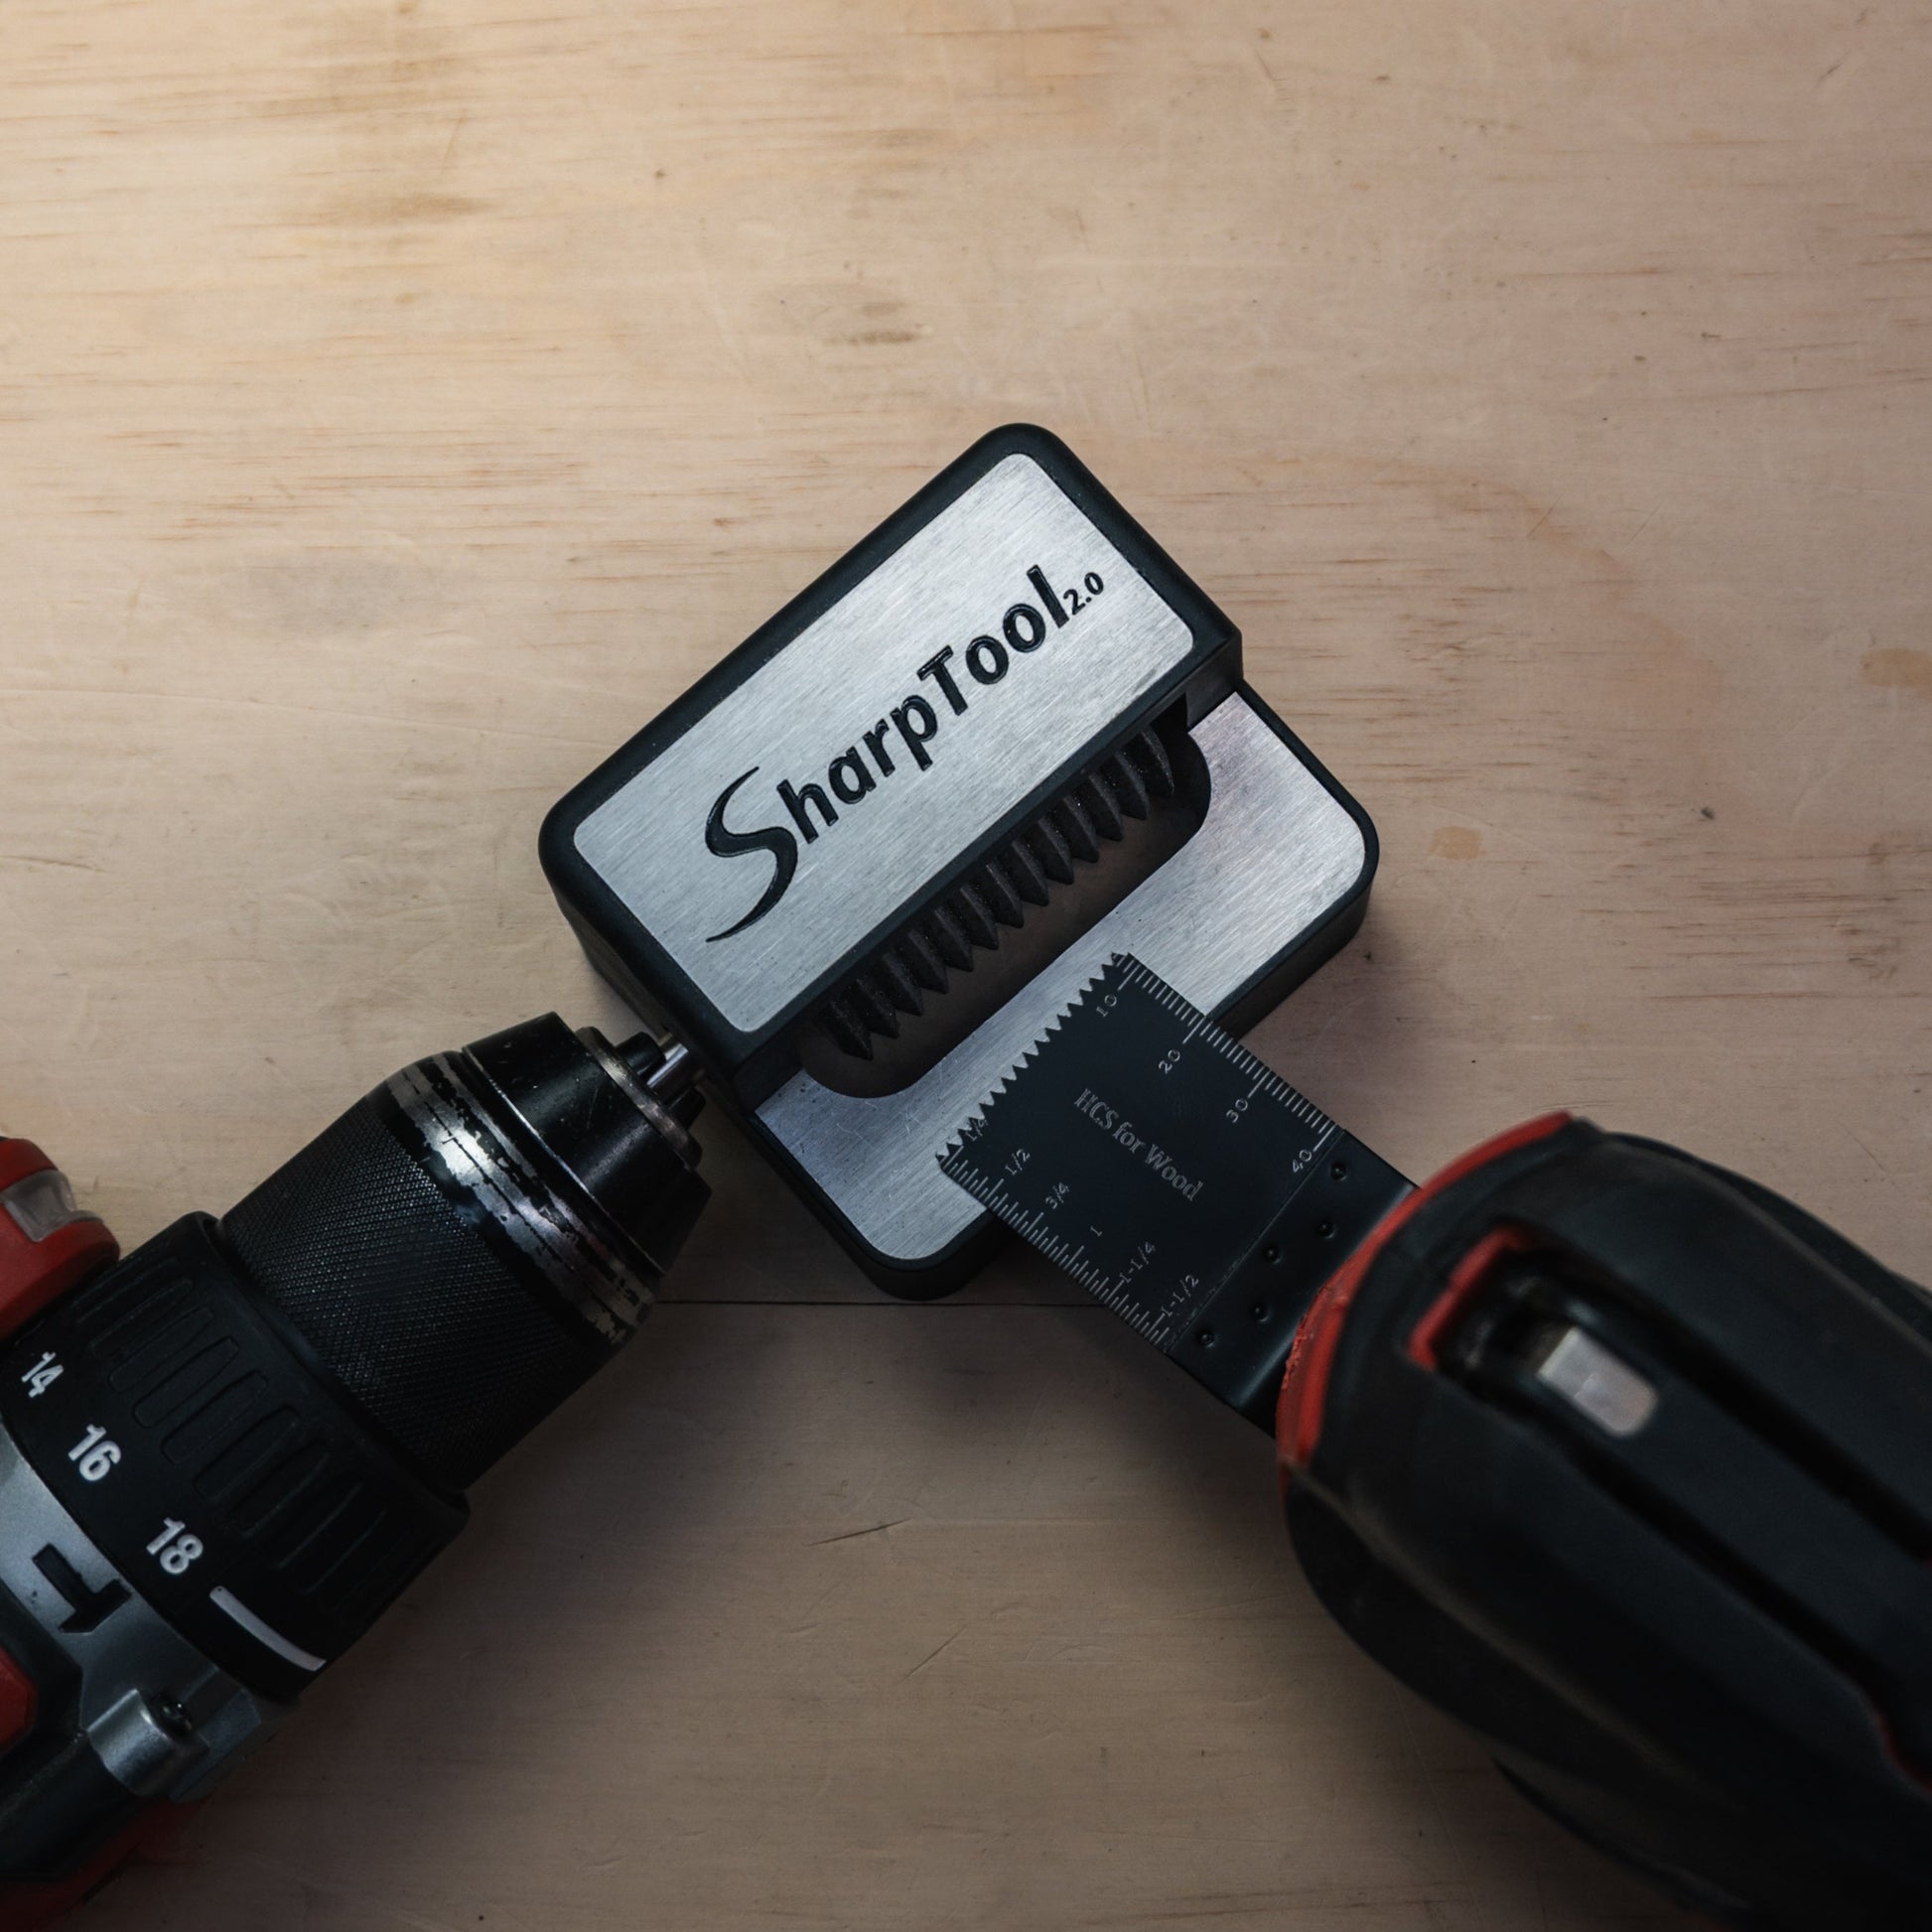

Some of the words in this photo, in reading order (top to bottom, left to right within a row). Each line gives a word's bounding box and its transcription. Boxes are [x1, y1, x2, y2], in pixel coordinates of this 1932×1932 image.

[705, 565, 1069, 942] SharpTool
[1063, 572, 1104, 615] 2.0
[1095, 994, 1118, 1018] 10
[1158, 1048, 1181, 1074] 20
[1226, 1098, 1249, 1123] 30
[1005, 1148, 1032, 1175] 1/2
[1074, 1088, 1119, 1130] HCS
[1112, 1121, 1146, 1154] for
[1145, 1144, 1203, 1201] Wood
[1292, 1149, 1312, 1173] 40
[1045, 1181, 1070, 1209] 3/4
[1161, 1274, 1199, 1316] 1-1/2
[21, 1351, 65, 1398] 14
[68, 1424, 122, 1481] 16
[146, 1517, 204, 1575] 18
